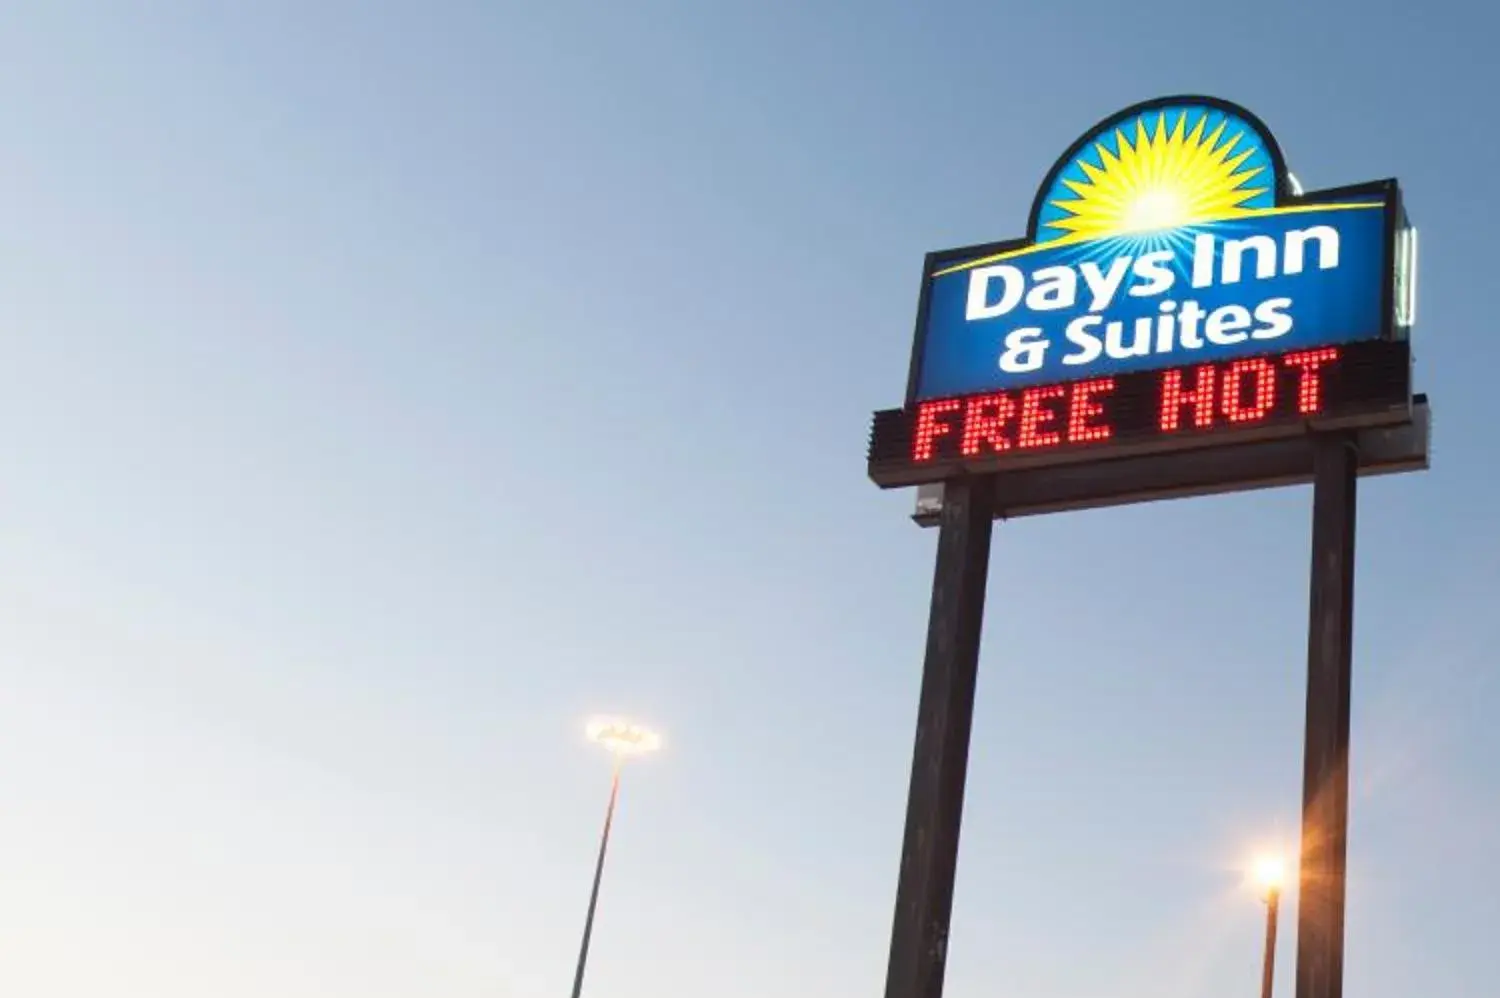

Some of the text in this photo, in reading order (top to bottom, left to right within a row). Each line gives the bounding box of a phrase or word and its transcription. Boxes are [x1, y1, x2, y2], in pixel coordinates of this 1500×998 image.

[964, 223, 1340, 321] Days Inn
[999, 296, 1293, 373] & Suites
[912, 346, 1339, 462] FREE HOT
